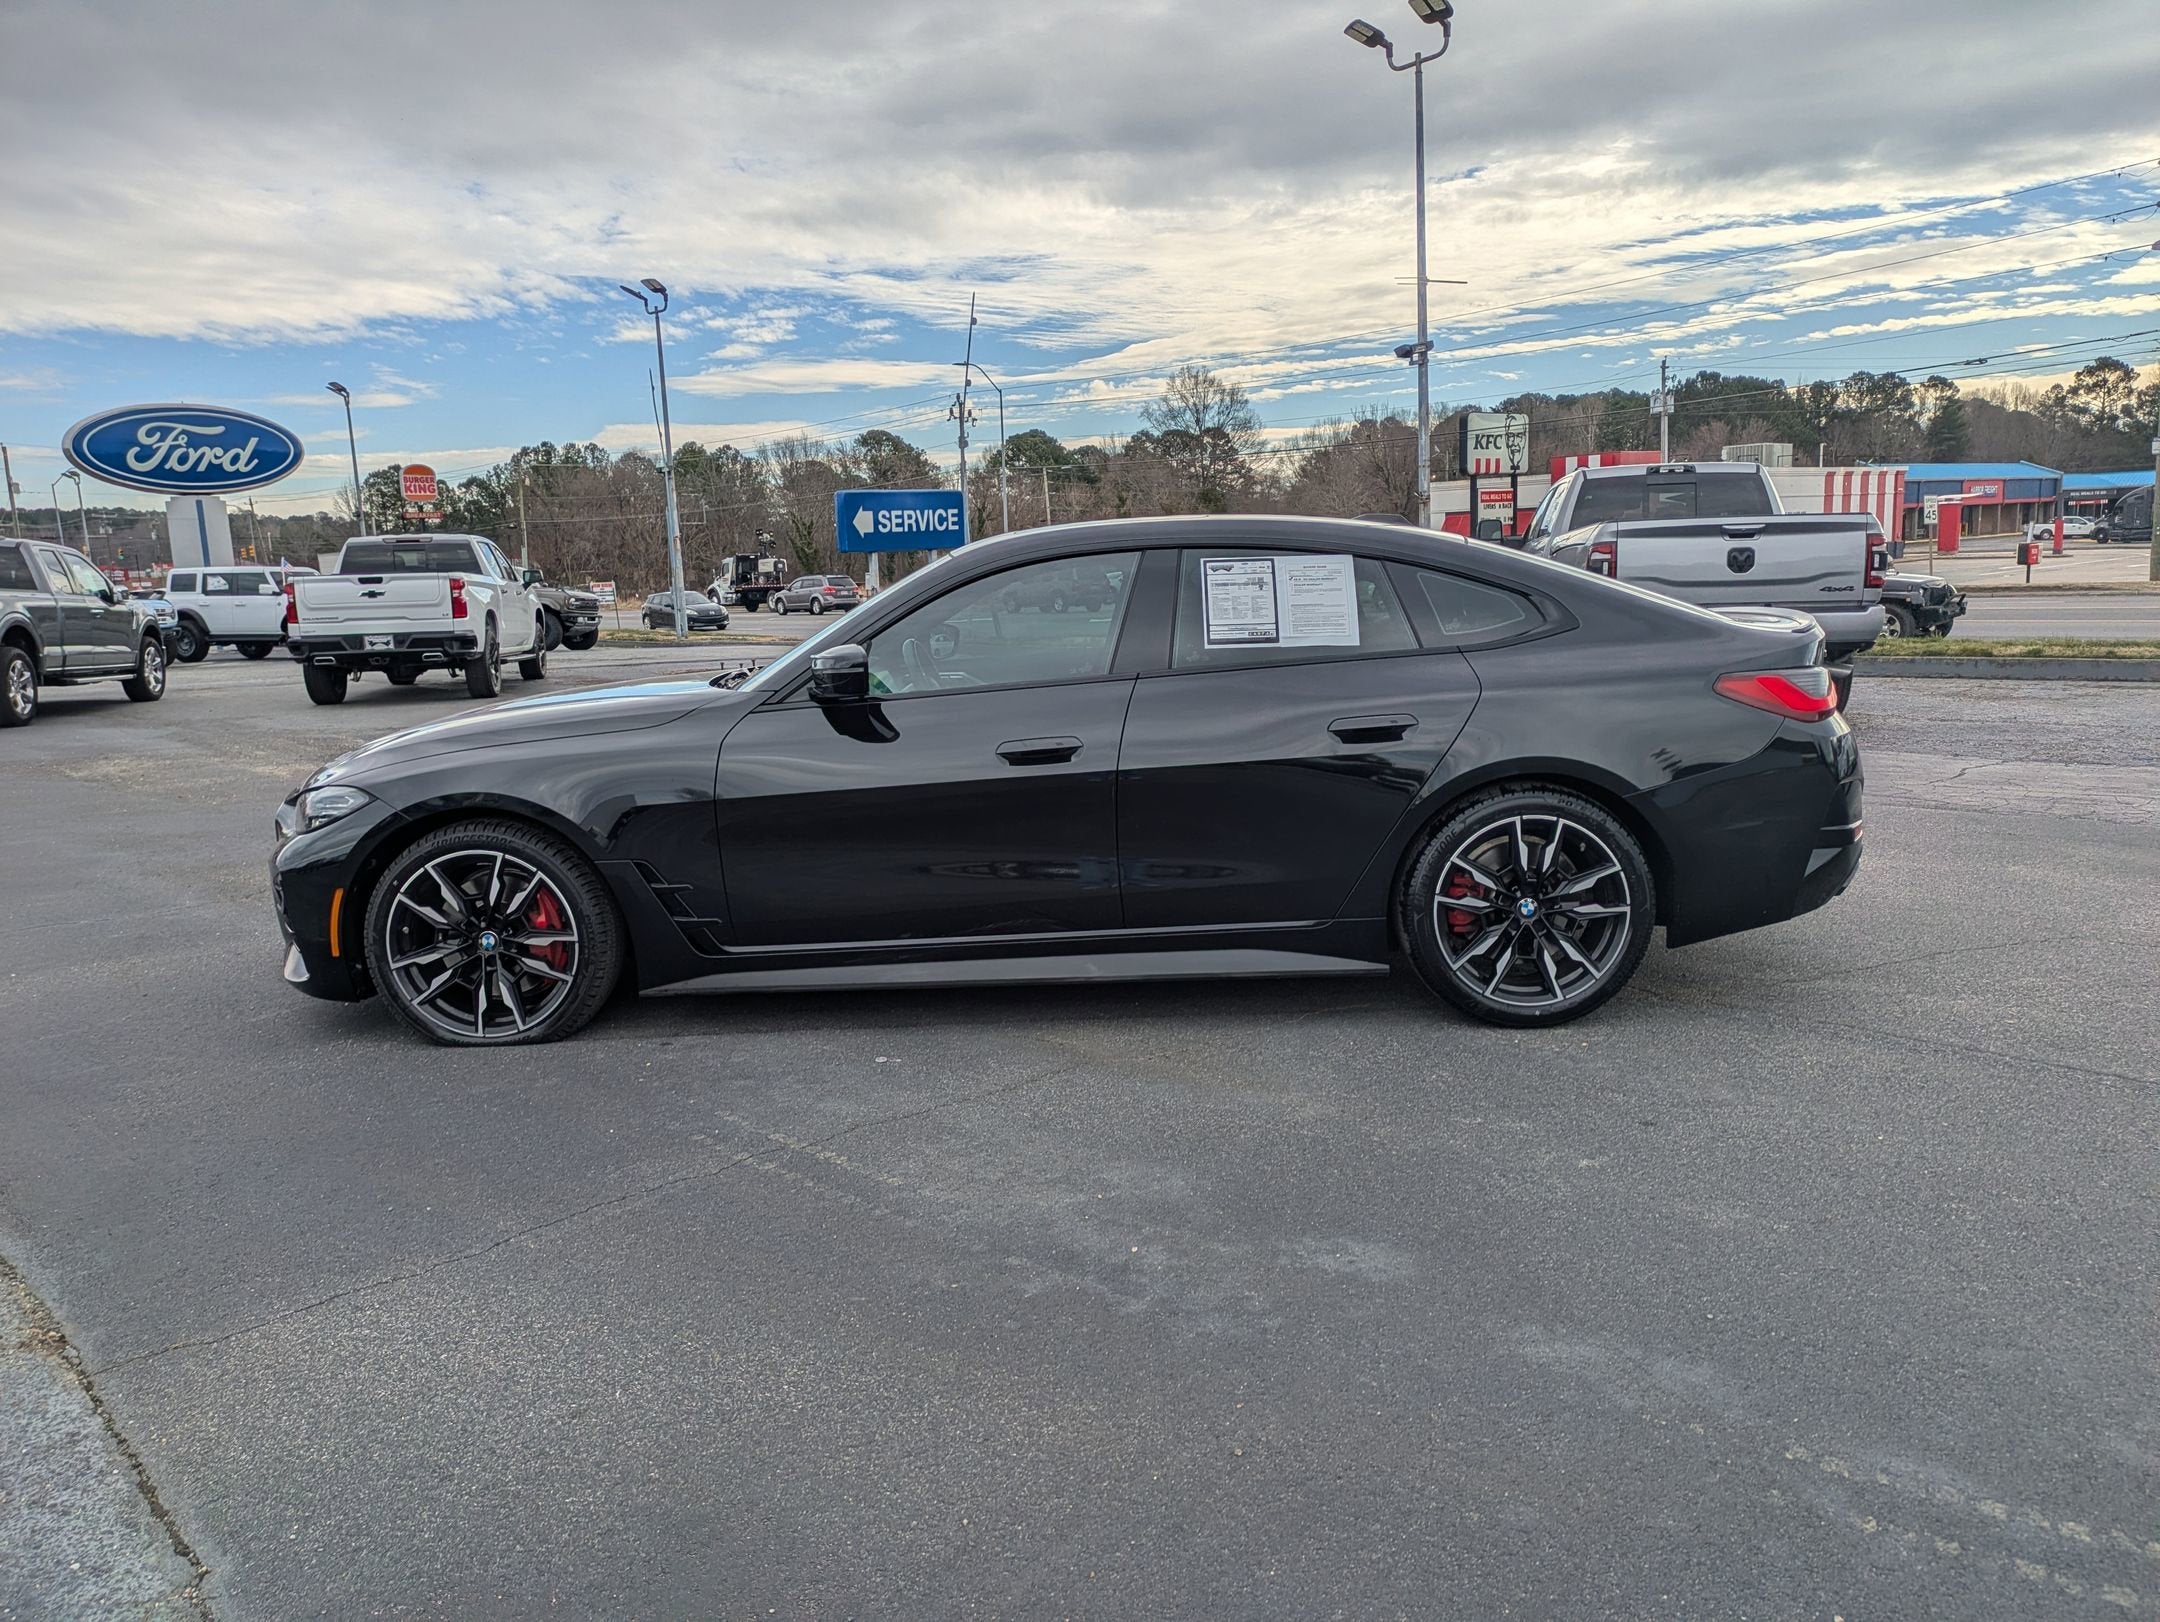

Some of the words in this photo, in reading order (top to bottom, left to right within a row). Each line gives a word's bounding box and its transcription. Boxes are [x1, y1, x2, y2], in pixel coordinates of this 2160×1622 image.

[126, 421, 260, 472] Ford
[1473, 433, 1503, 450] KFC
[403, 475, 435, 484] BURGER
[404, 484, 436, 494] KING
[878, 508, 960, 533] SERVICE
[1925, 509, 1937, 520] 45
